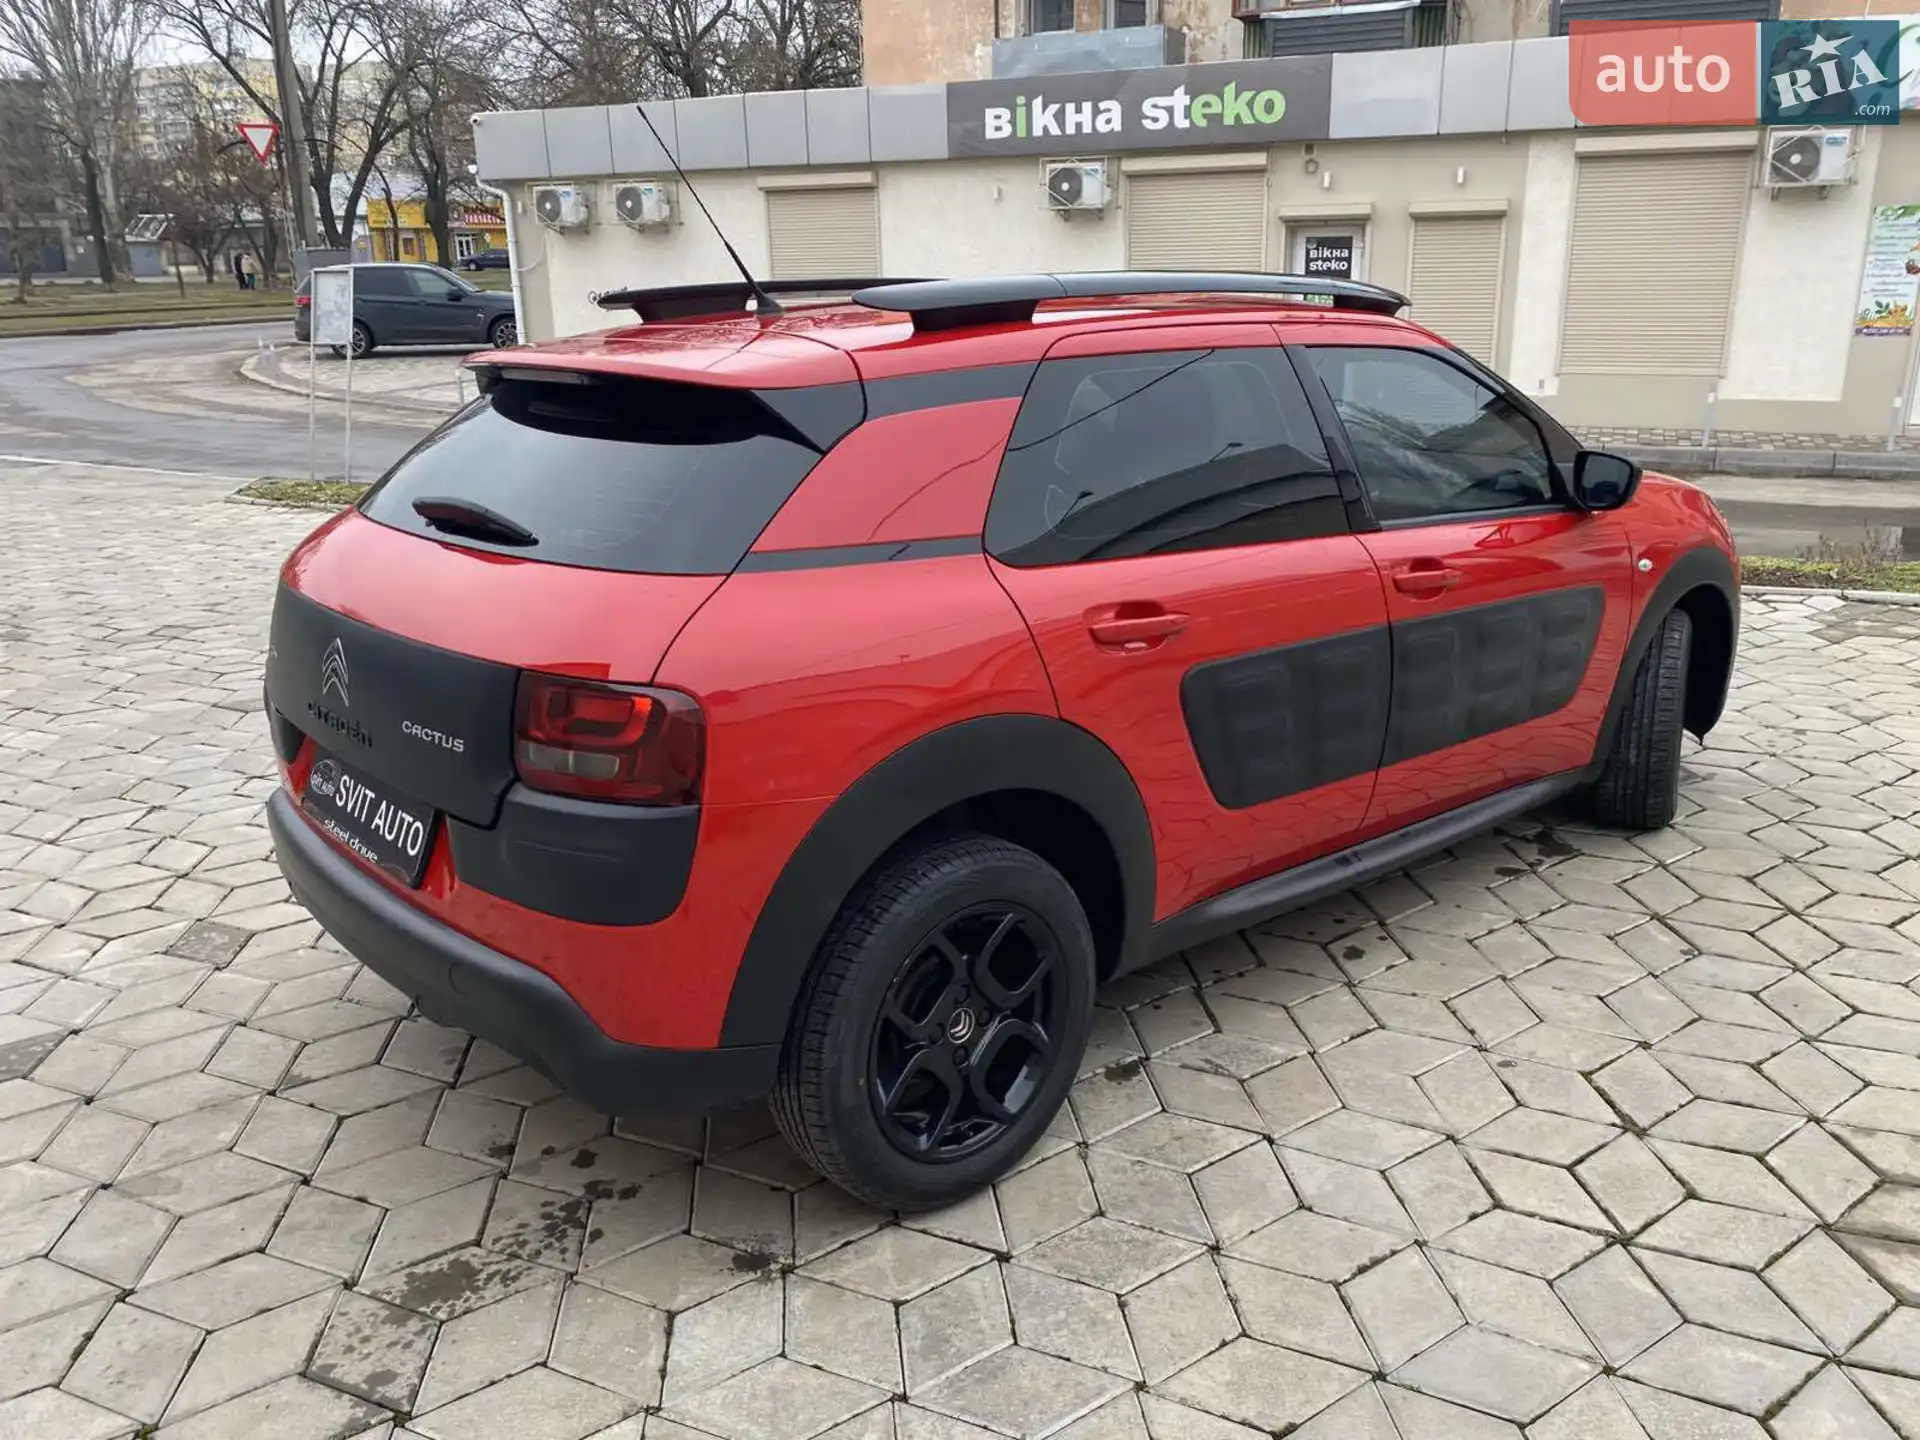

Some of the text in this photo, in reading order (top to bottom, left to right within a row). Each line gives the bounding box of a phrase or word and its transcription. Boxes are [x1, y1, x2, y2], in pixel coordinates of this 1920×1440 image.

[1141, 80, 1286, 130] steko
[1309, 259, 1348, 271] steko
[402, 720, 465, 752] CACTUS
[335, 774, 424, 857] SVIT AUTO
[324, 819, 378, 864] steel drive
